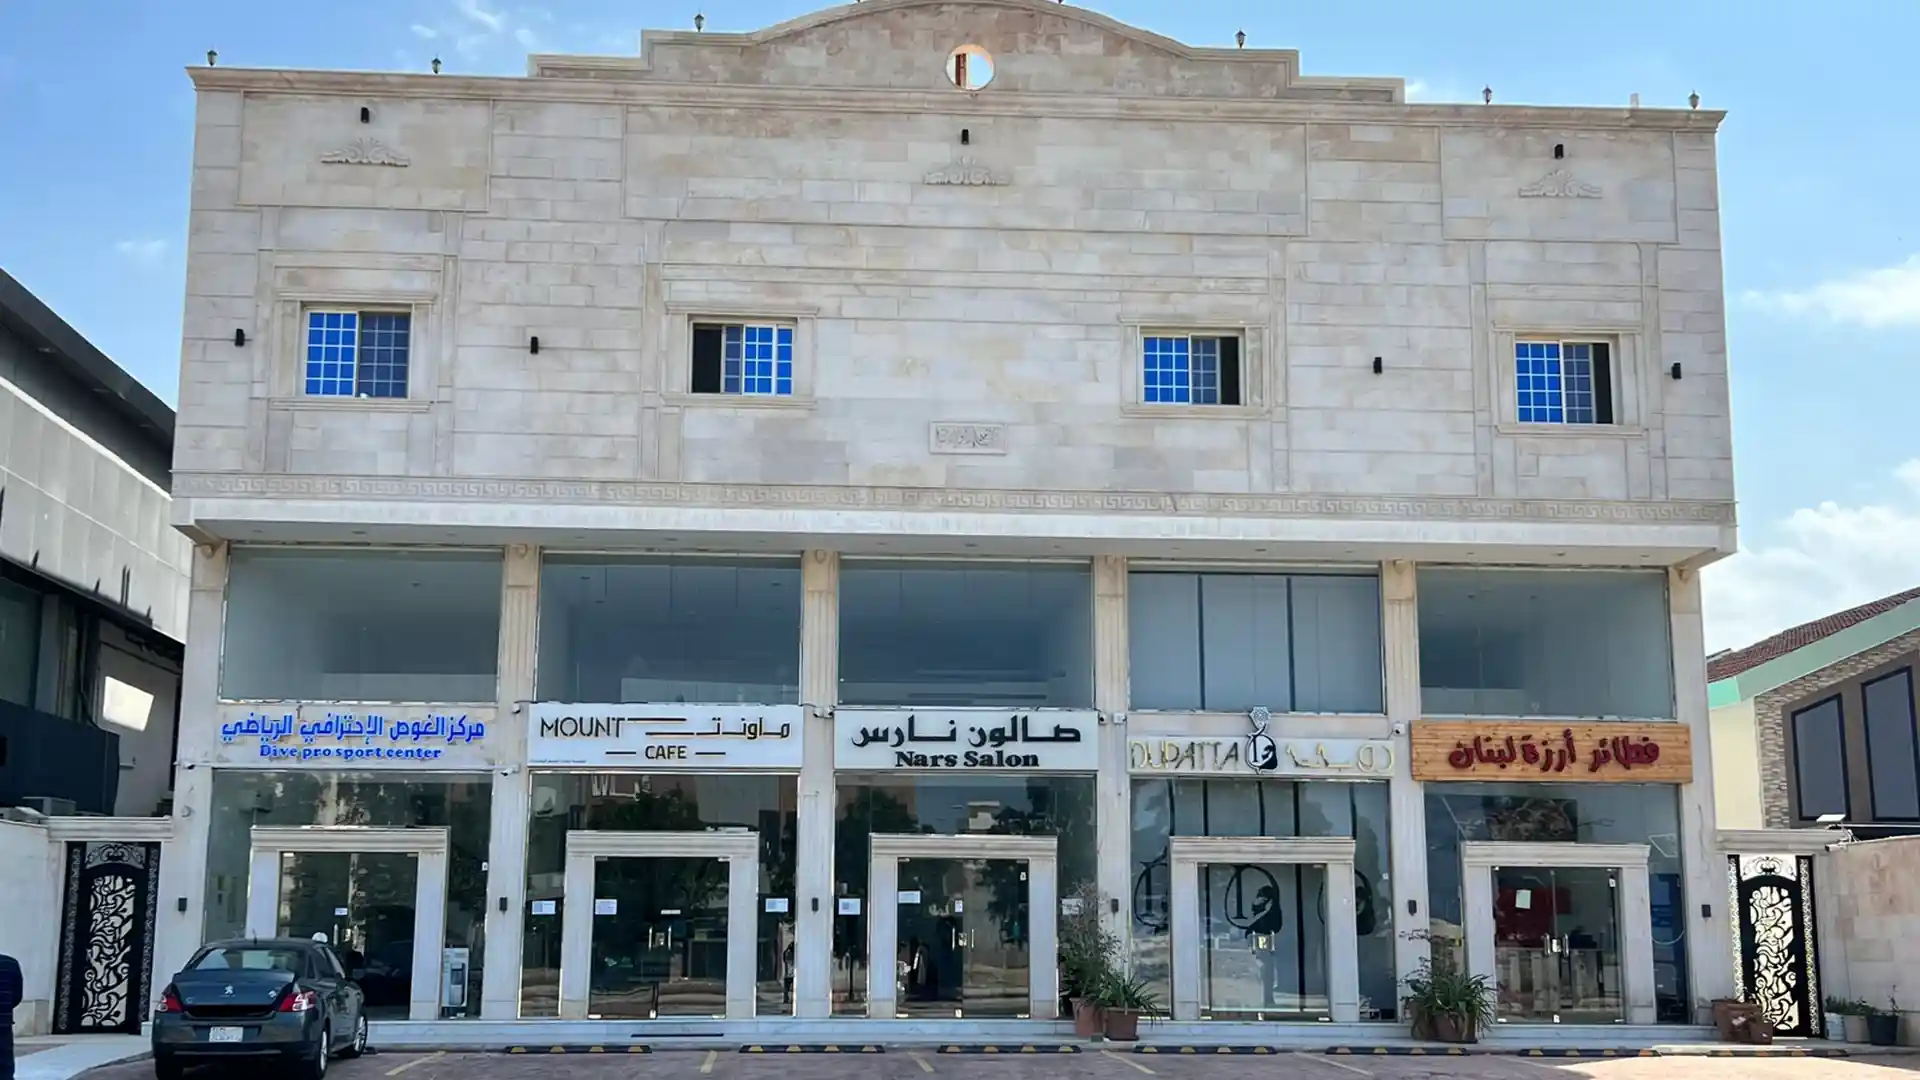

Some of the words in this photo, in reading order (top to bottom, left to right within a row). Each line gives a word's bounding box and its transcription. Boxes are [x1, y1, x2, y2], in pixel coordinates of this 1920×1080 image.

[220, 712, 293, 742] الرياضي
[389, 713, 446, 742] الغوص
[447, 715, 486, 743] مركز
[540, 716, 626, 738] MOUNT
[851, 715, 957, 747] نارس
[967, 715, 1081, 747] صالون
[258, 744, 298, 758] Dive
[302, 746, 333, 762] pro
[335, 744, 381, 761] sport
[385, 745, 442, 759] center
[644, 745, 688, 760] CAFE
[895, 750, 958, 768] Nars
[963, 750, 1040, 768] Salon
[1131, 741, 1240, 770] DUPATTA
[1448, 734, 1517, 769] لبنان
[1520, 728, 1577, 773] أرزة
[1588, 735, 1660, 772] فطائر
